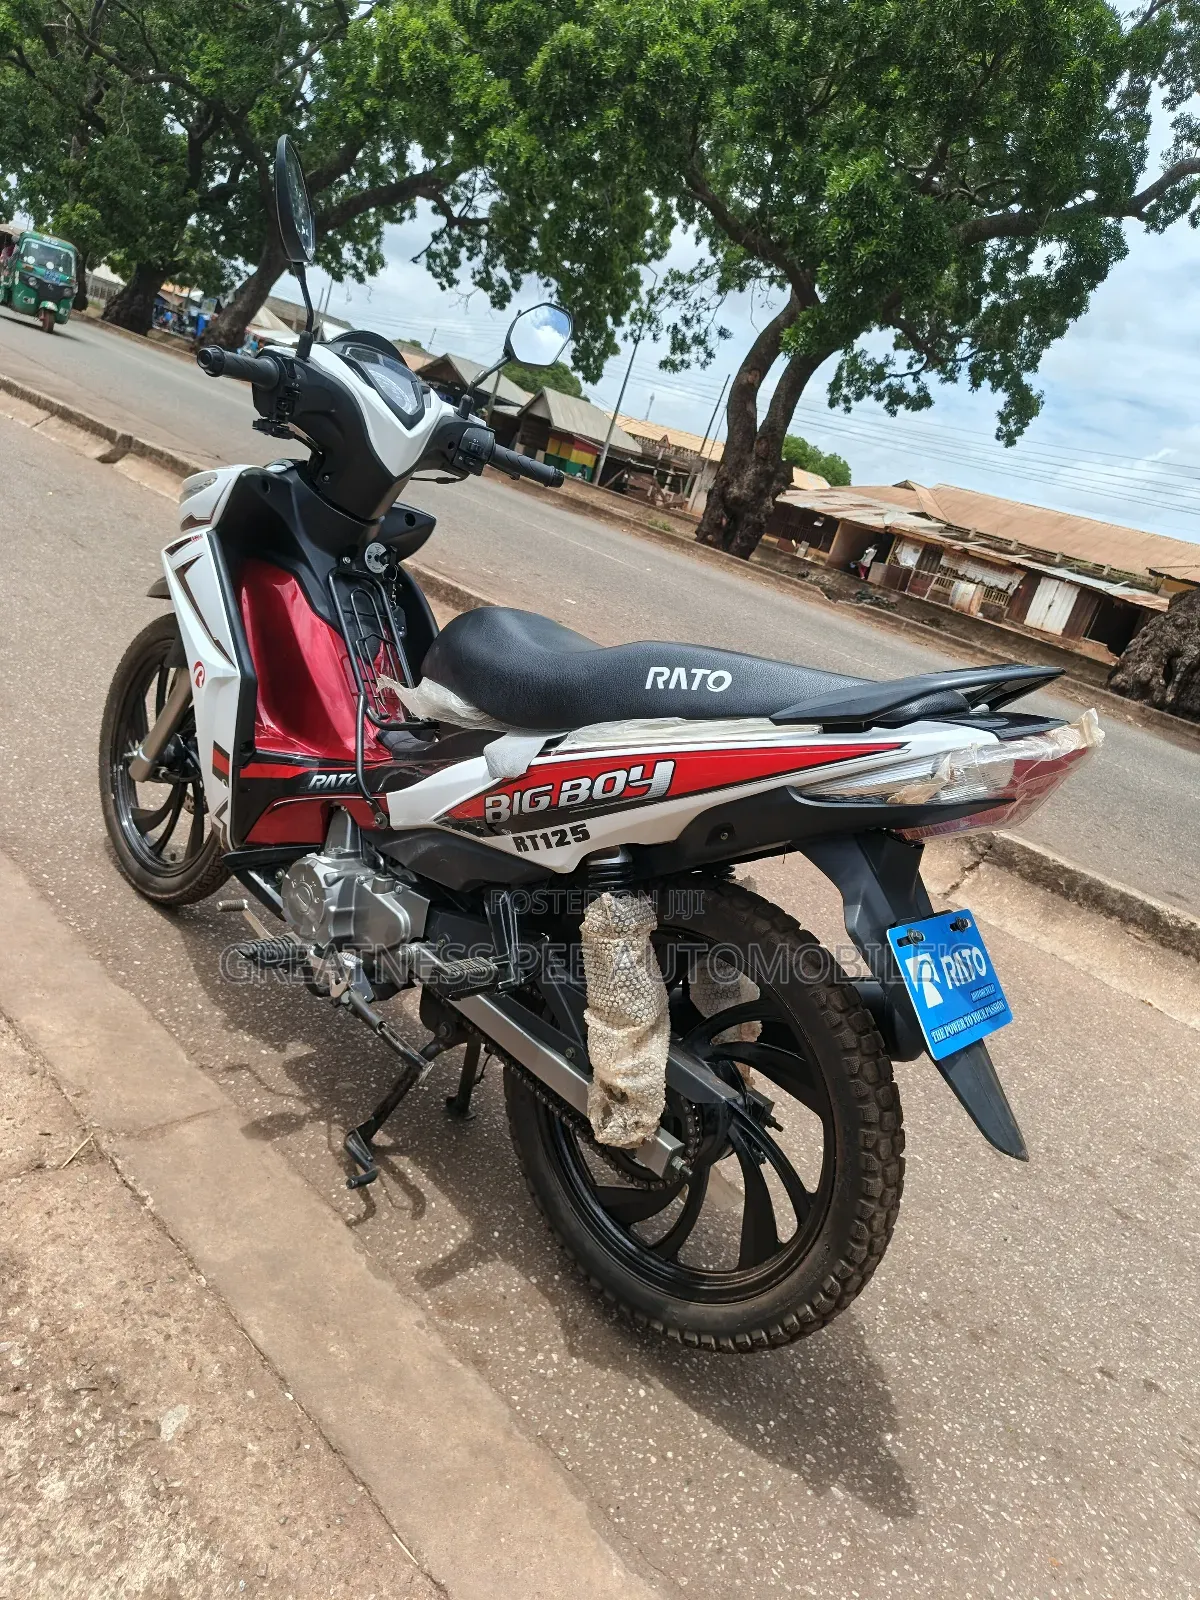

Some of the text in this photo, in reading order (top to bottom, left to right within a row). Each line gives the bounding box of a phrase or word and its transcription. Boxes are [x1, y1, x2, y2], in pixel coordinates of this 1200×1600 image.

[645, 666, 733, 693] RATO
[484, 784, 554, 825] BIG
[512, 823, 591, 852] RT125
[940, 946, 987, 989] RATO
[931, 1027, 947, 1043] THE
[944, 1017, 967, 1037] POWER
[963, 1014, 974, 1028] TO
[970, 1008, 988, 1024] YOUR
